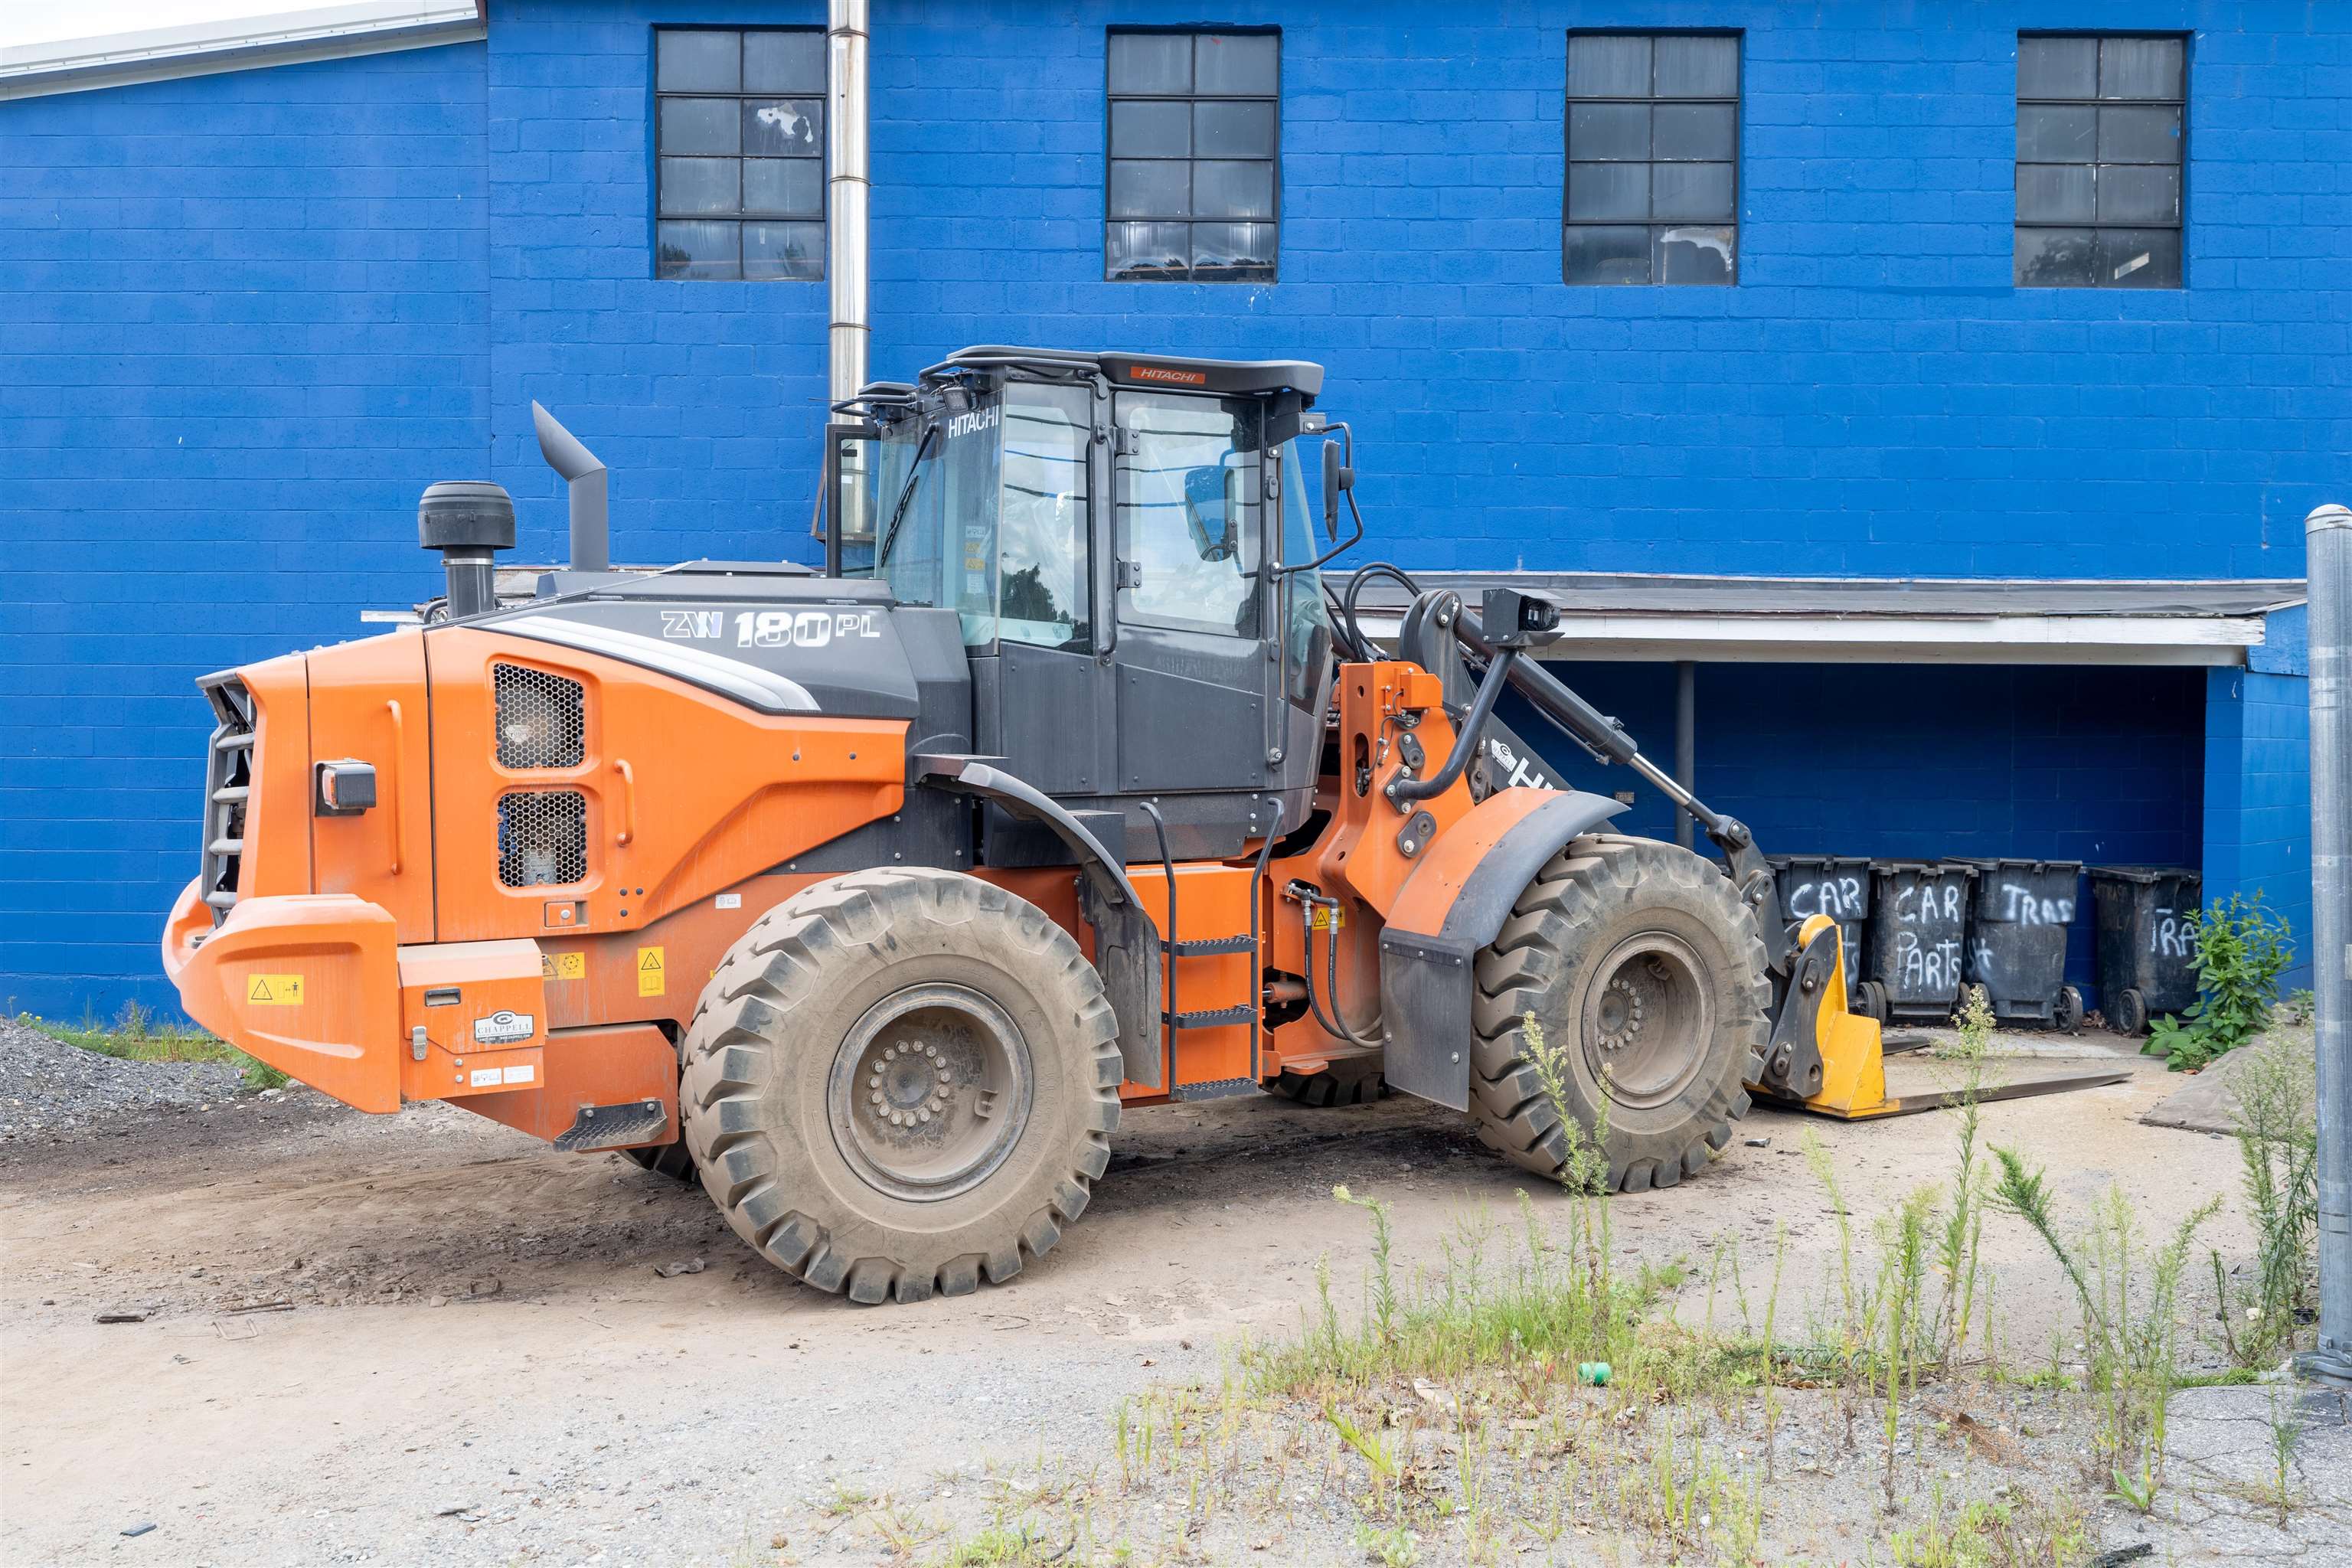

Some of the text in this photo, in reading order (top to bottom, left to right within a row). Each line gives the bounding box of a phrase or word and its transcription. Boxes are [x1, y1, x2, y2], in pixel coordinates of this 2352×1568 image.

[1140, 368, 1197, 381] HITACHI
[948, 404, 999, 439] HITACHI
[661, 611, 724, 639] ZW
[1790, 877, 1861, 918] CAR
[1895, 886, 1959, 924] CAR
[1896, 931, 1962, 993] PARTS
[478, 1023, 531, 1034] CHAPPELL
